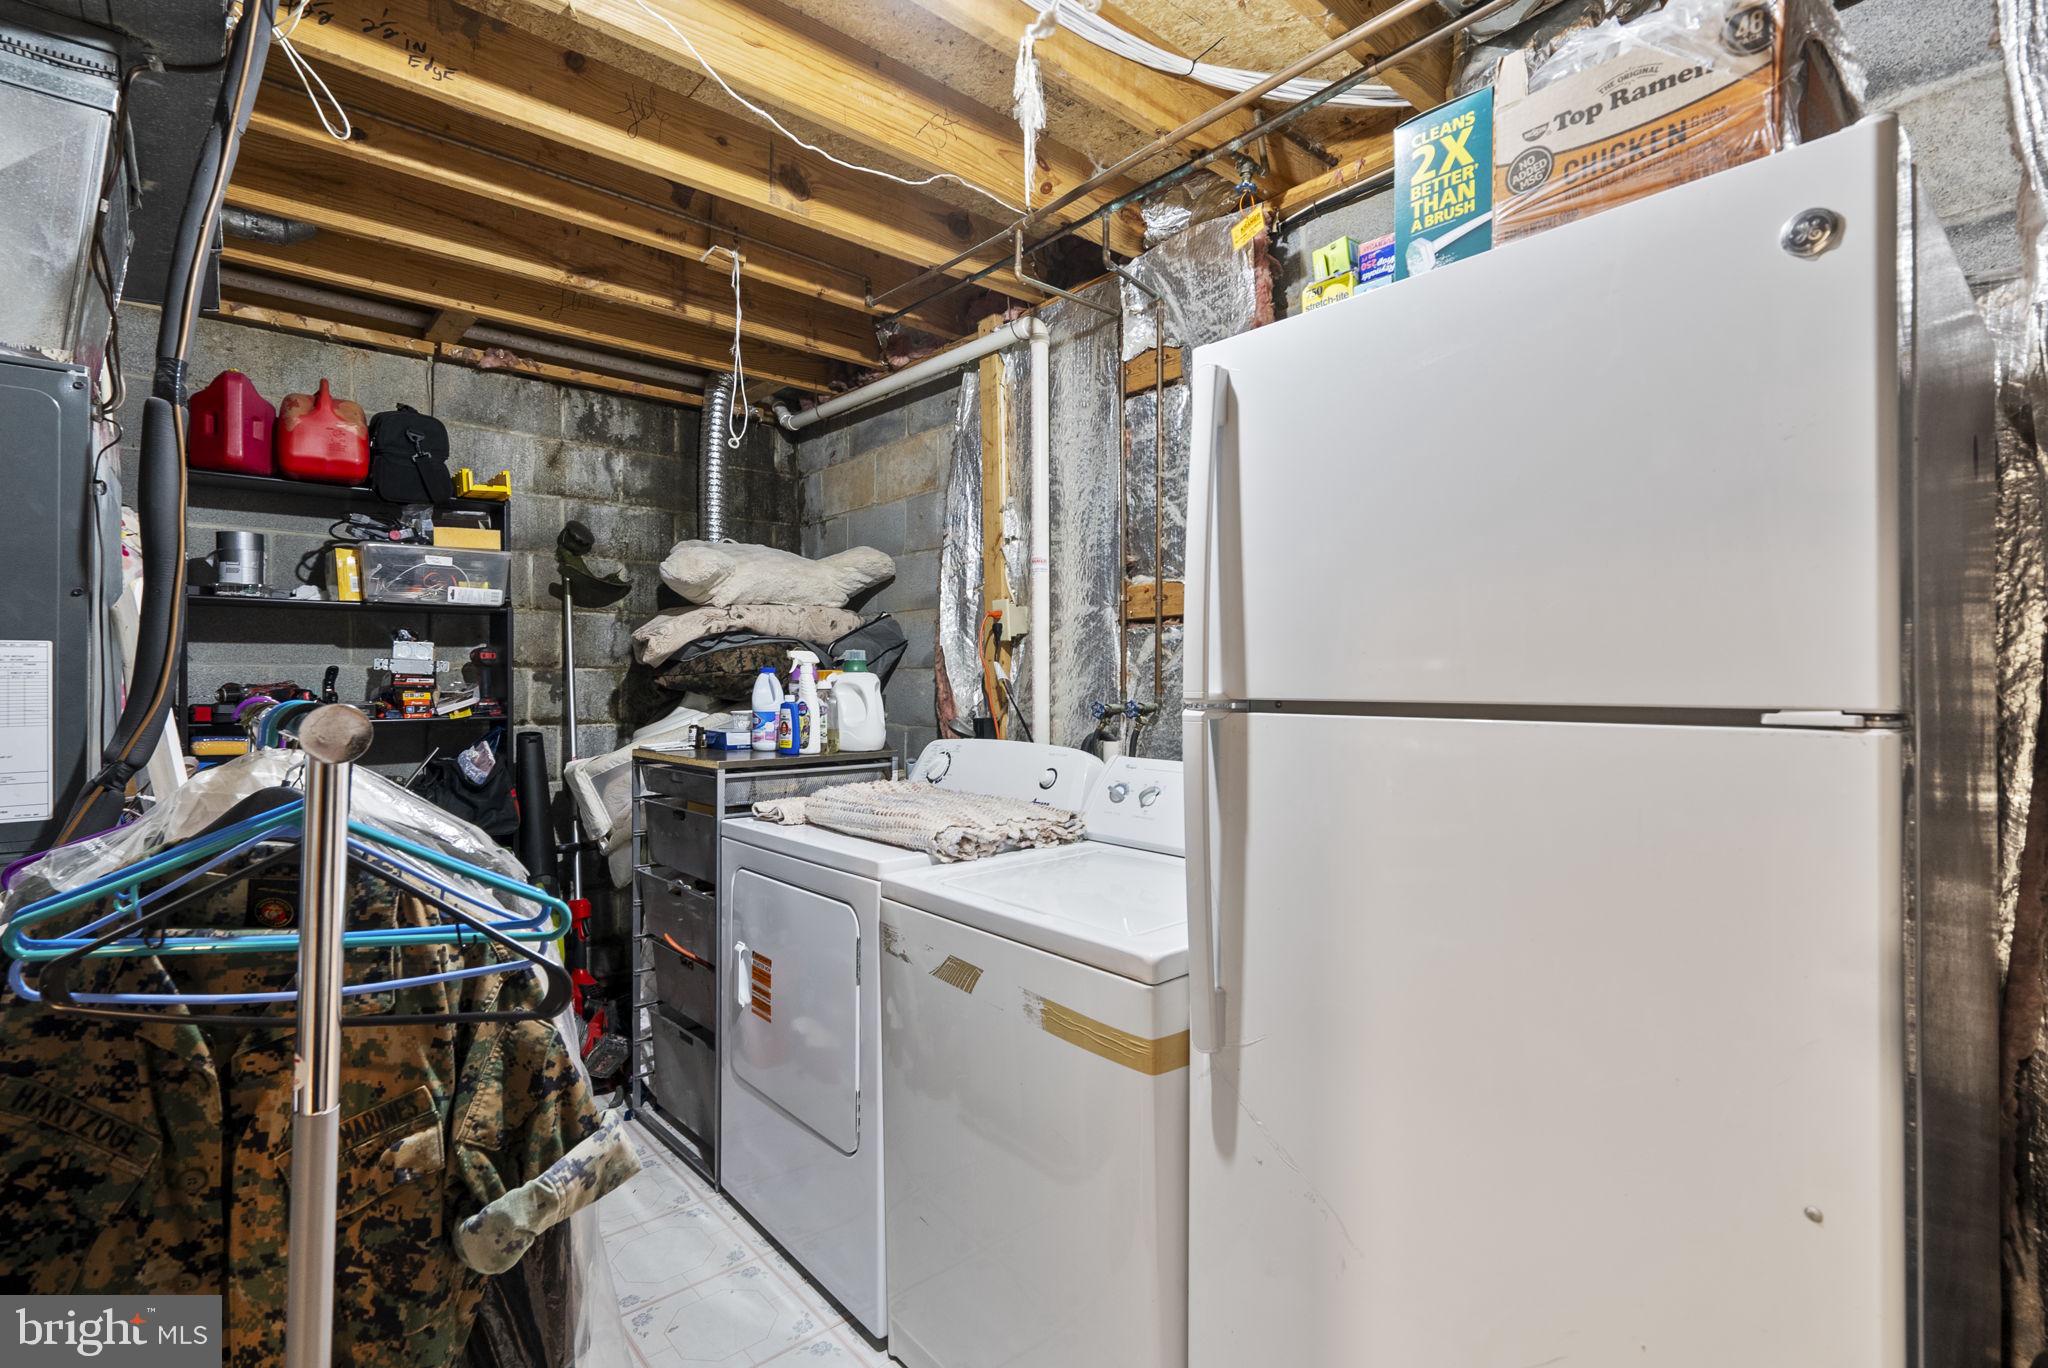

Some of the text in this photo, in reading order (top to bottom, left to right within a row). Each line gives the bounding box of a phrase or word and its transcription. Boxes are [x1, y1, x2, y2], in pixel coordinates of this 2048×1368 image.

[1599, 66, 1660, 94] THE ORIGINAL
[1411, 111, 1476, 149] CLEANS
[1554, 103, 1603, 131] Top
[1411, 125, 1475, 187] 2X
[1518, 155, 1535, 171] NO
[1564, 119, 1687, 186] CHICKEN
[1512, 158, 1547, 185] ADDED
[1410, 199, 1476, 234] A BRUSH
[1411, 180, 1476, 219] THAN
[1361, 259, 1376, 271] 250
[11, 1084, 142, 1155] HARTZOGE
